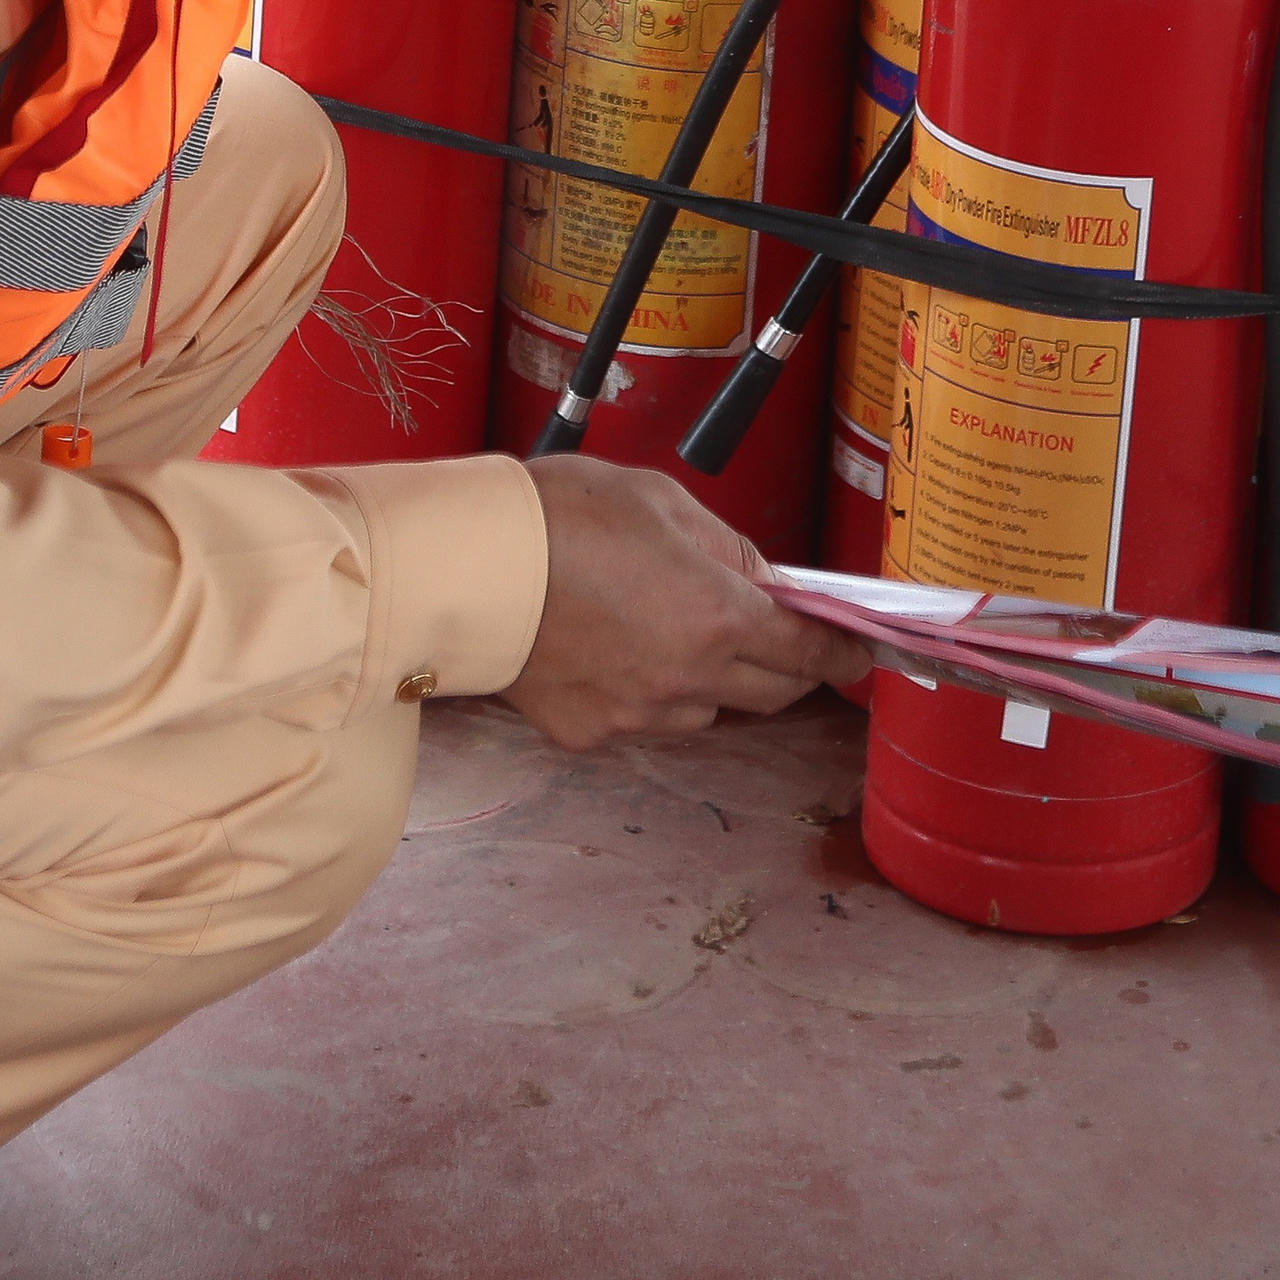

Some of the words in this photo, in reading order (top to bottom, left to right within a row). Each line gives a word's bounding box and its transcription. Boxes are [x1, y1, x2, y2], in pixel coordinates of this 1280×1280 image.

[946, 183, 958, 213] Dry
[957, 188, 986, 220] Powder
[986, 200, 1003, 226] Fire
[1003, 205, 1061, 238] Extinguisher
[1064, 214, 1130, 248] MFZL8
[566, 292, 593, 317] IN
[949, 407, 1075, 453] EXPLANATION
